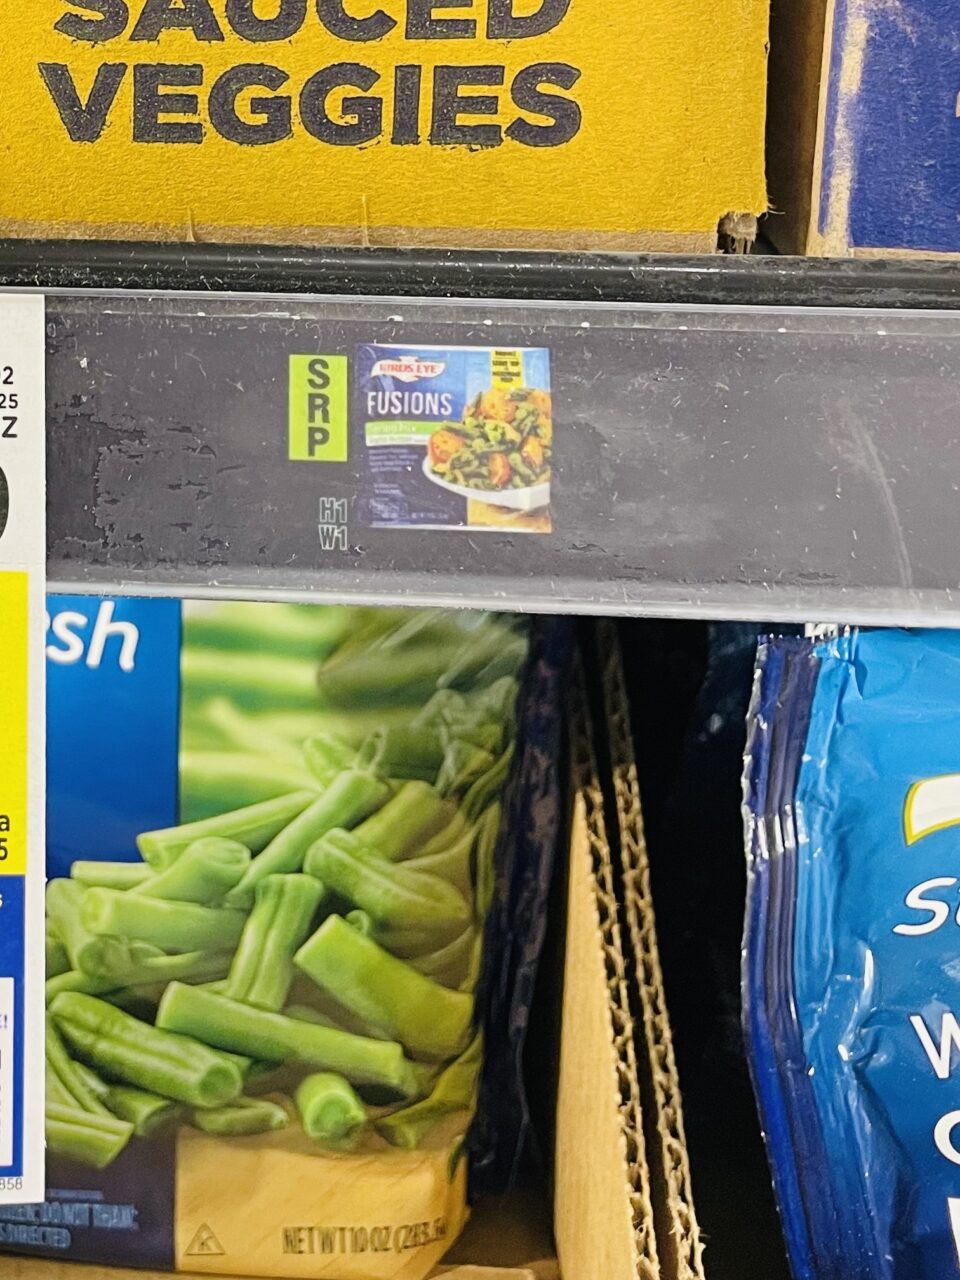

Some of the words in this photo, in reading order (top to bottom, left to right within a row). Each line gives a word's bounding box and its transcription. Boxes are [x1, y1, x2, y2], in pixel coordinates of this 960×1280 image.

[38, 61, 583, 148] VEGGIES
[367, 390, 453, 416] FUSIONS
[46, 600, 140, 673] sh
